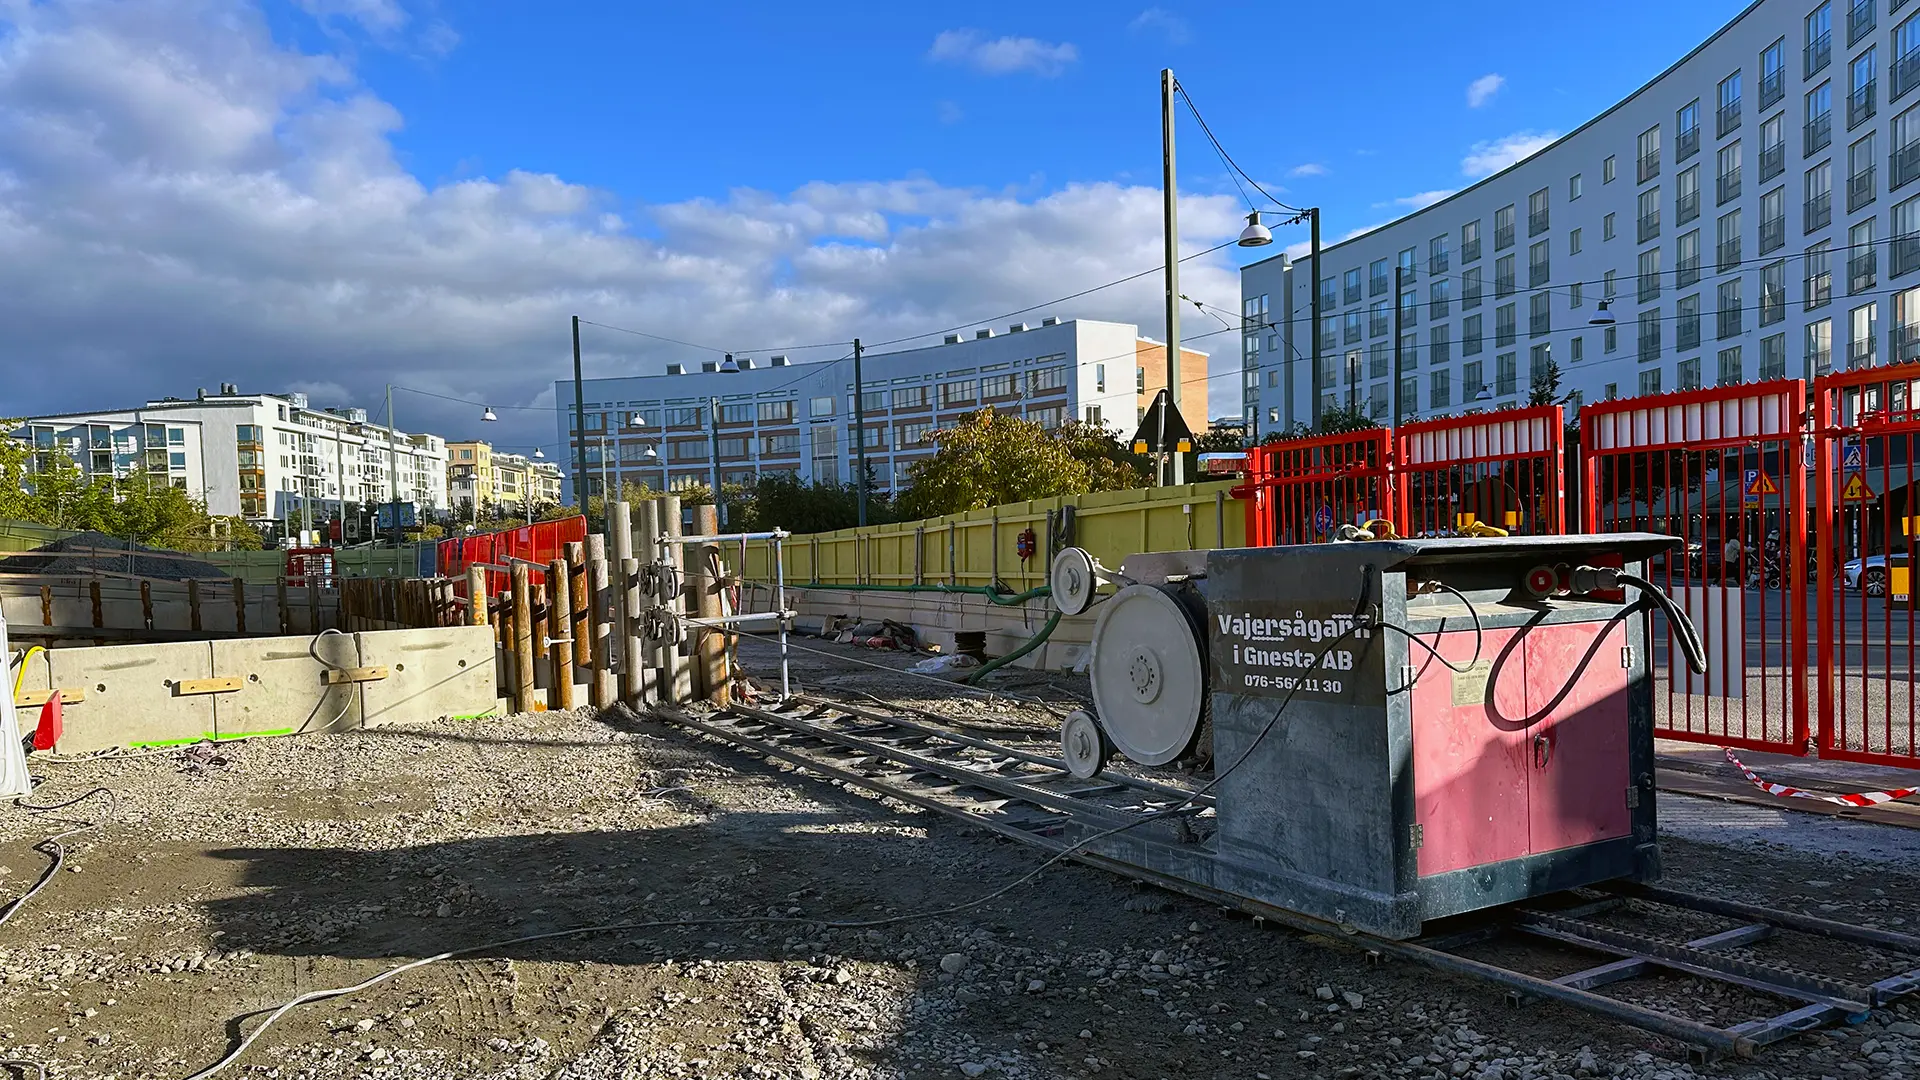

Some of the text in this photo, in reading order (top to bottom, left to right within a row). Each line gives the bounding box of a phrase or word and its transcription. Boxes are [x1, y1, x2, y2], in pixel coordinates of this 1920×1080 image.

[1233, 644, 1353, 671] i Gnesta AB
[1305, 678, 1319, 692] 11
[1323, 680, 1342, 694] 30
